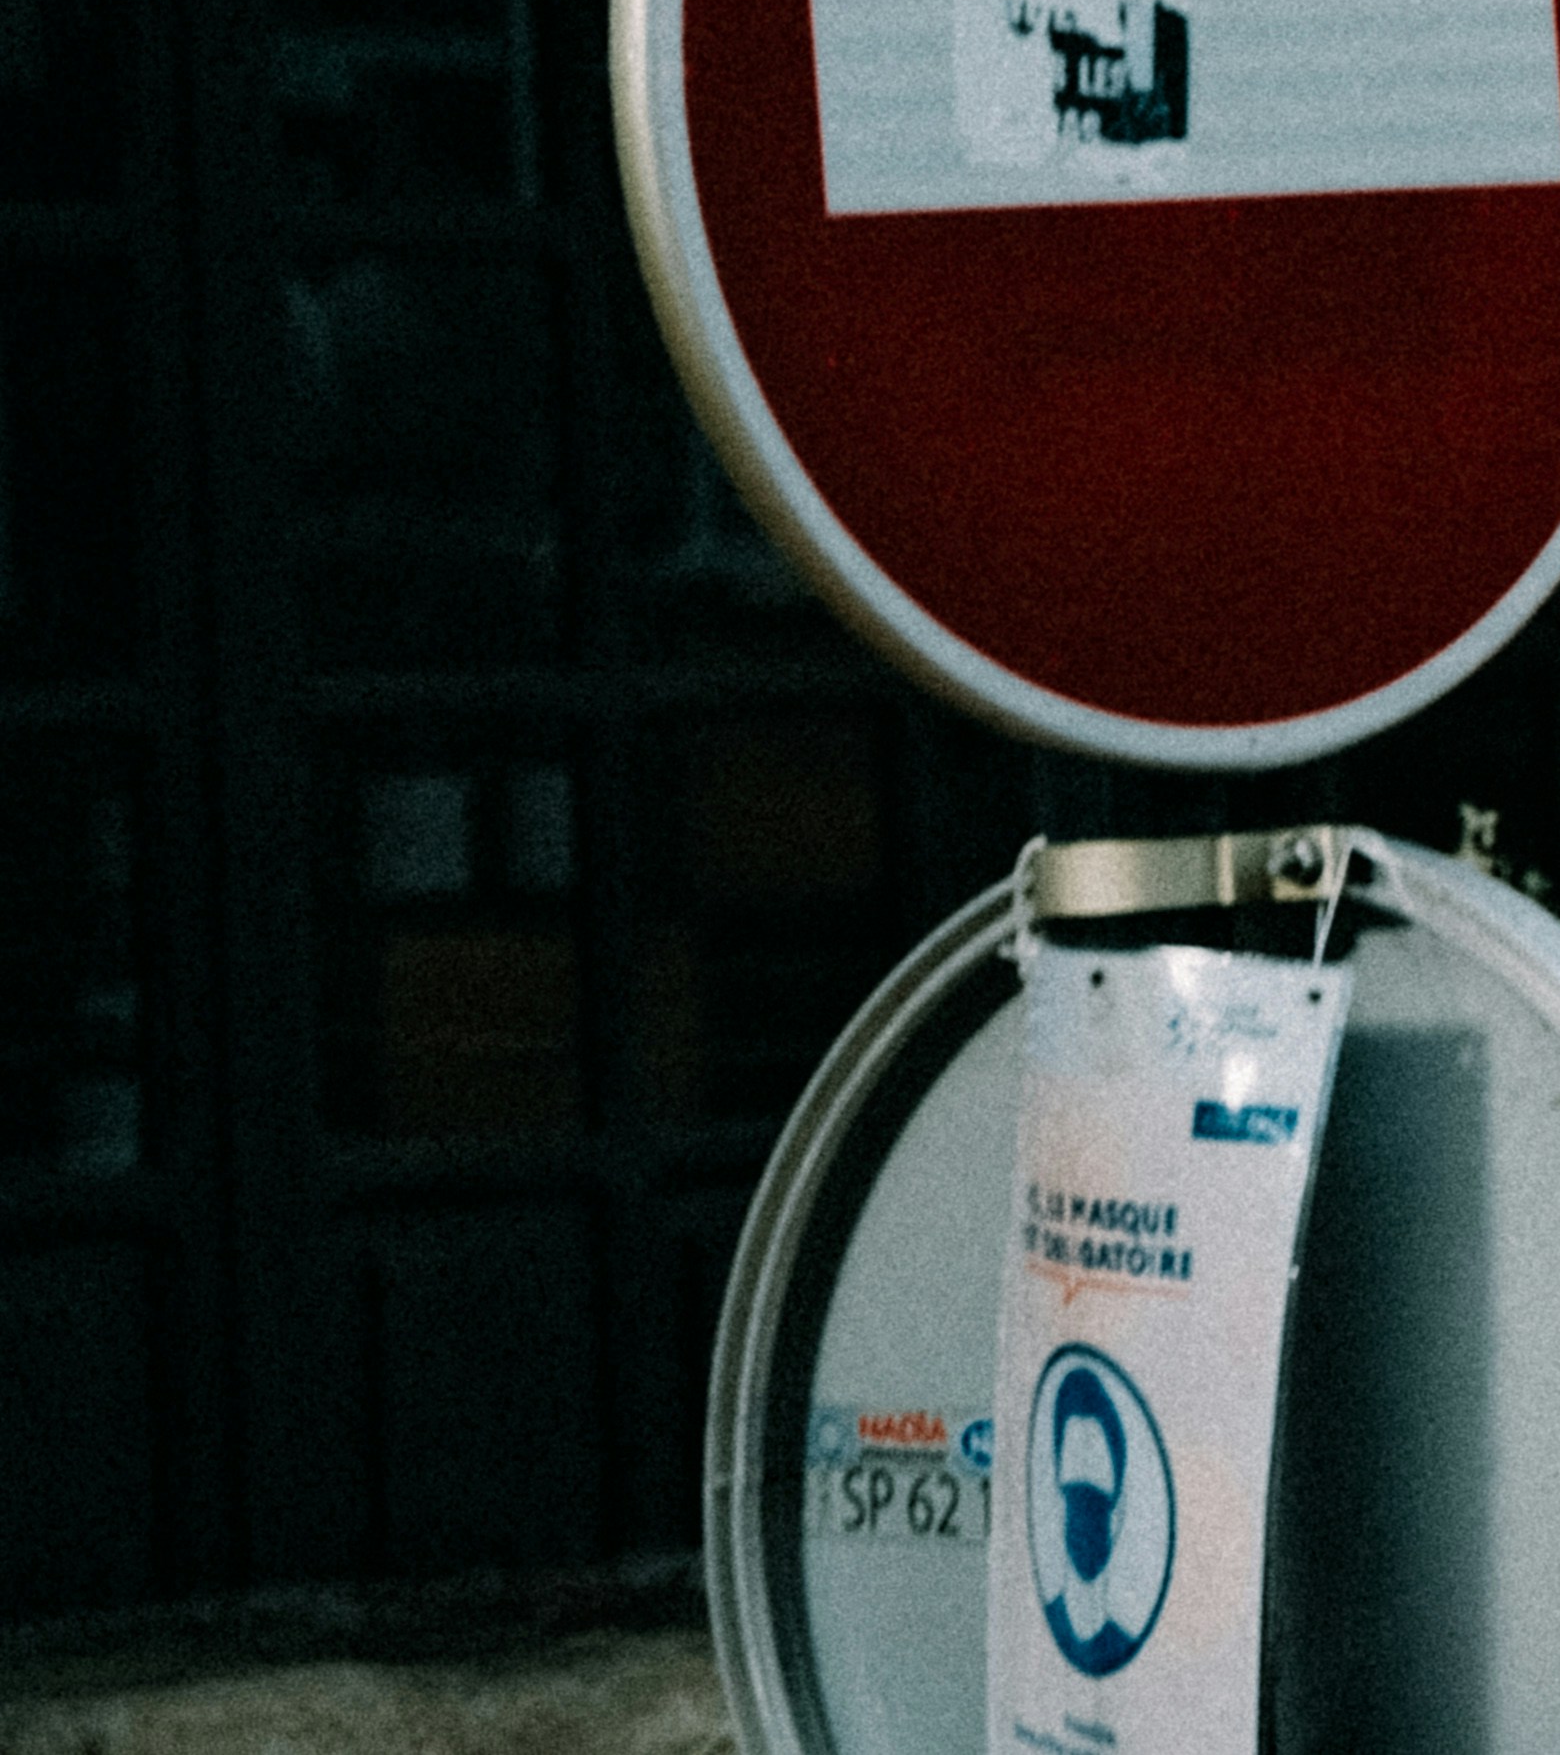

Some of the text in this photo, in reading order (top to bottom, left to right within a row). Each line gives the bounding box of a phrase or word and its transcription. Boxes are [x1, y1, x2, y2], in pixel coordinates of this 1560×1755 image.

[1070, 1195, 1177, 1237] MASQUE
[841, 1464, 895, 1535] SP
[906, 1472, 962, 1539] 62
